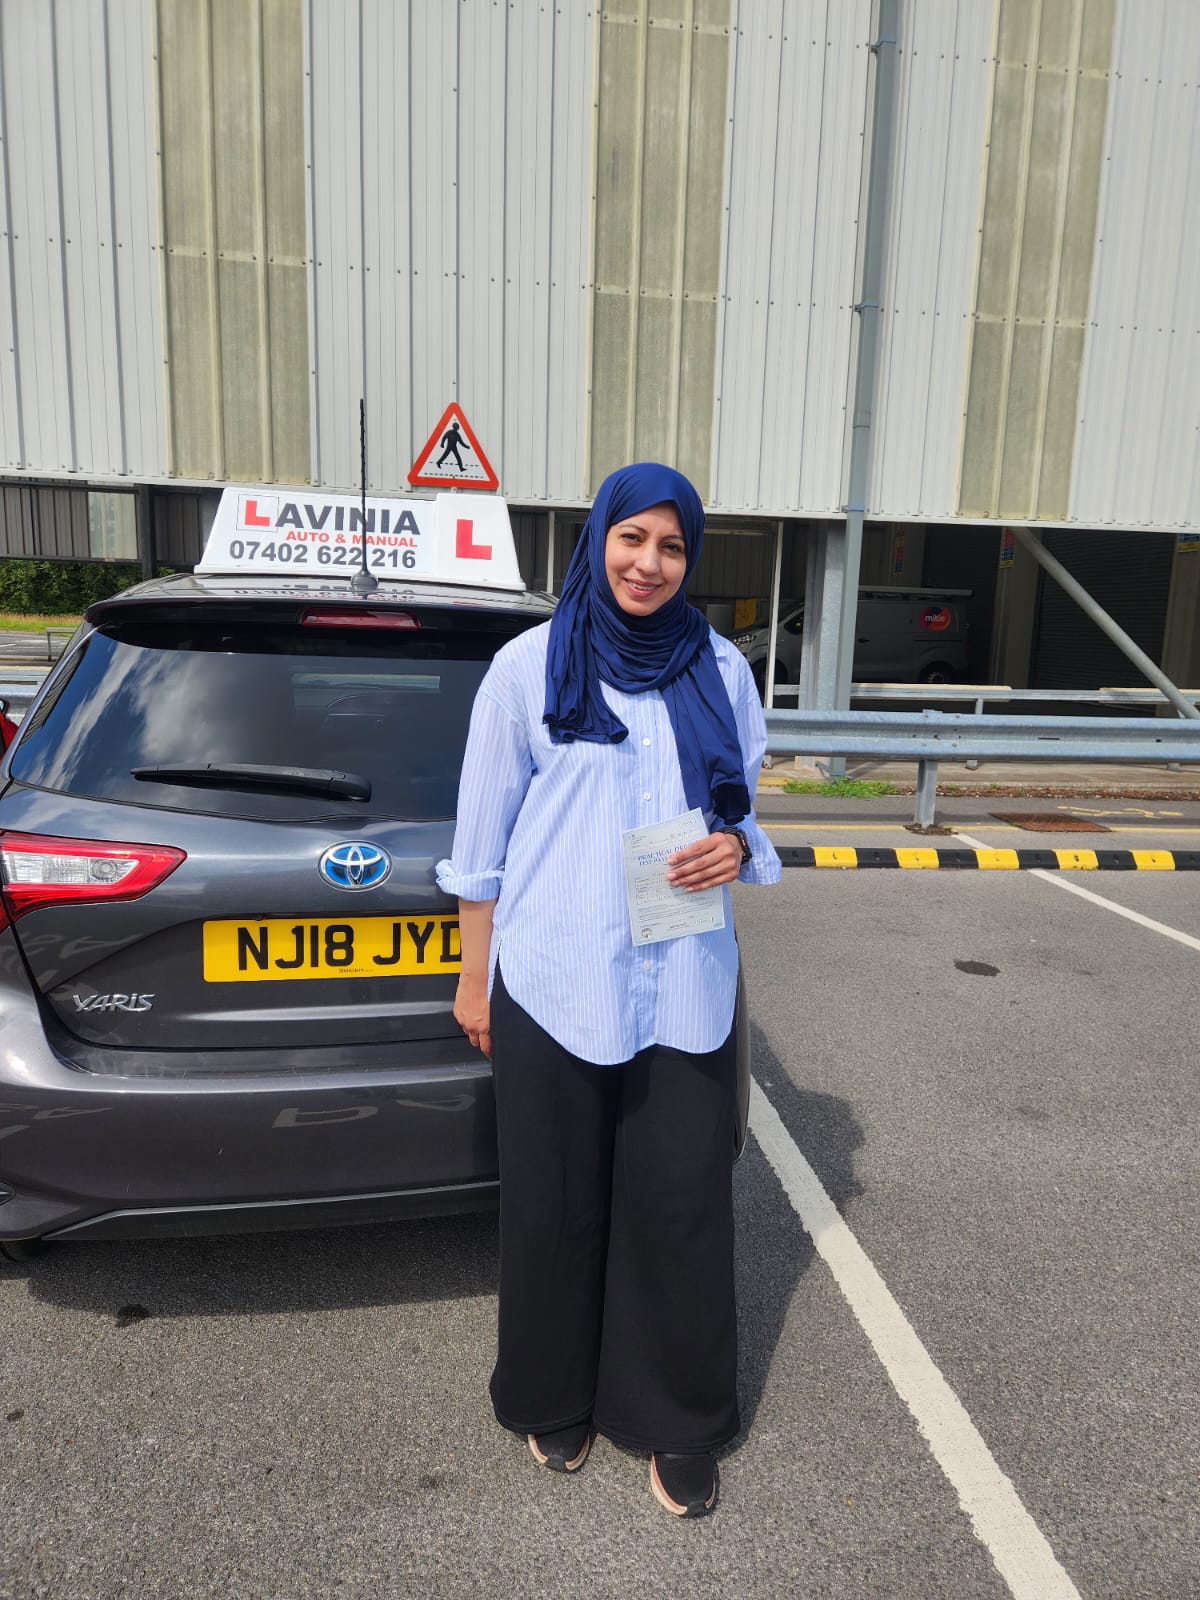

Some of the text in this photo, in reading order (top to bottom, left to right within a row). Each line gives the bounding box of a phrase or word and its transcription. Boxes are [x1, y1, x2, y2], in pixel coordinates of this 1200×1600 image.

[245, 500, 421, 535] LAVINIA
[229, 540, 416, 569] 07402 622 216
[286, 531, 418, 548] AUTO & MANUAL
[454, 519, 493, 561] L
[237, 924, 354, 971] NJ18
[72, 993, 155, 1012] YARIS
